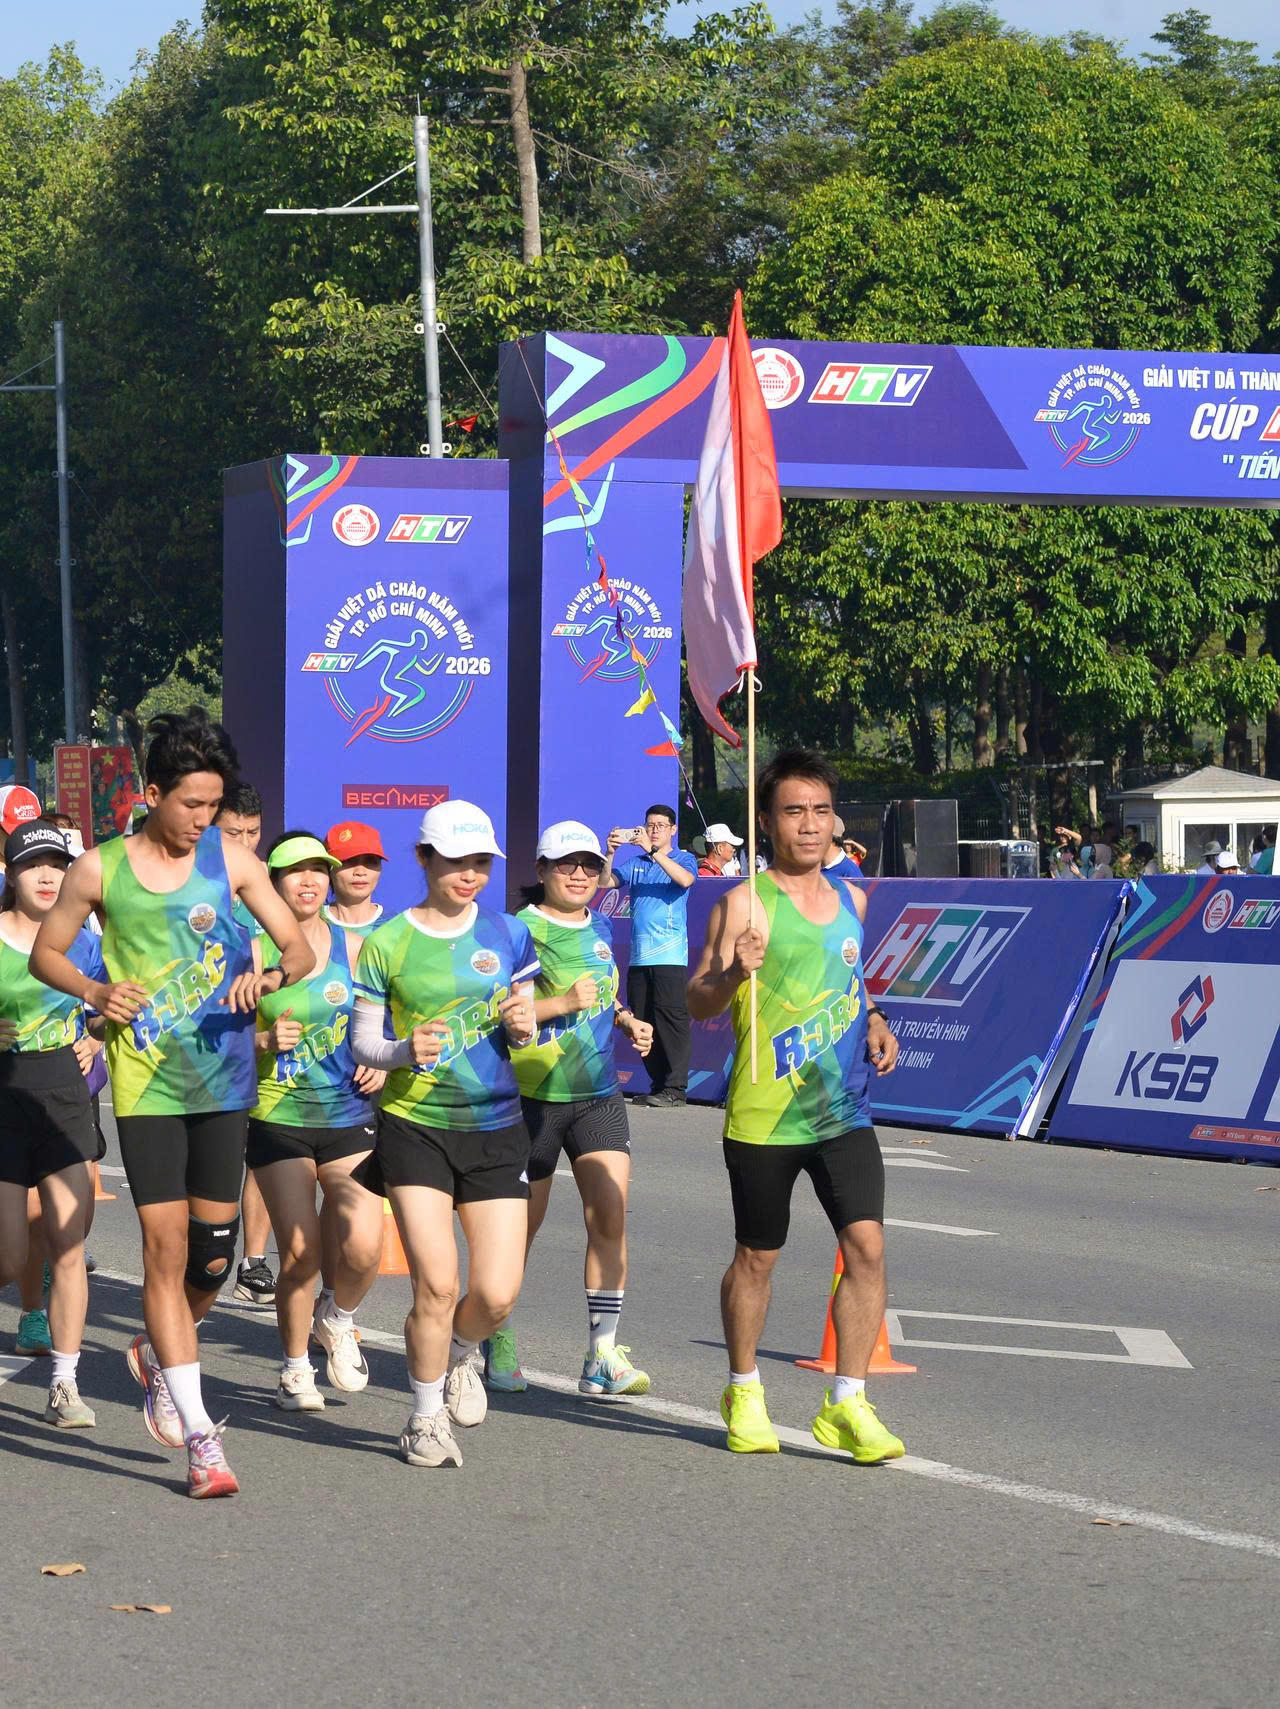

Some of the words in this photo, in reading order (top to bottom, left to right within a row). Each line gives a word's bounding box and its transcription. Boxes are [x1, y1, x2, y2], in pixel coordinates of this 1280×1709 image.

[819, 371, 923, 397] HTV
[1056, 372, 1073, 390] VIỆT
[1143, 364, 1173, 388] GIẢI
[1177, 367, 1210, 391] VIỆT
[1214, 368, 1235, 389] DÃ
[1088, 377, 1104, 387] CHÍ
[1104, 380, 1125, 402] MINH
[1122, 412, 1151, 424] 2026
[1190, 397, 1259, 440] CÚP
[393, 519, 464, 538] HTV
[575, 585, 592, 605] VIỆT
[624, 595, 645, 616] MINH
[324, 618, 345, 649] GIẢI
[337, 593, 365, 621] VIỆT
[365, 580, 387, 602] DÃ
[389, 580, 427, 600] CHÀO
[427, 591, 459, 622] NĂM
[452, 619, 475, 651] MỚI
[349, 619, 370, 638] TP.
[367, 600, 387, 623] HỒ
[390, 601, 415, 617] CHÍ
[415, 607, 449, 640] MINH
[643, 627, 672, 638] 2026
[306, 655, 354, 670] HTV
[445, 656, 491, 675] 2026
[1234, 906, 1280, 923] HTV
[863, 923, 1009, 984] HTV
[902, 1016, 944, 1039] TRUYỀN
[941, 1020, 970, 1041] HÌNH
[905, 1051, 935, 1069] MINH
[1115, 1051, 1219, 1102] KSB
